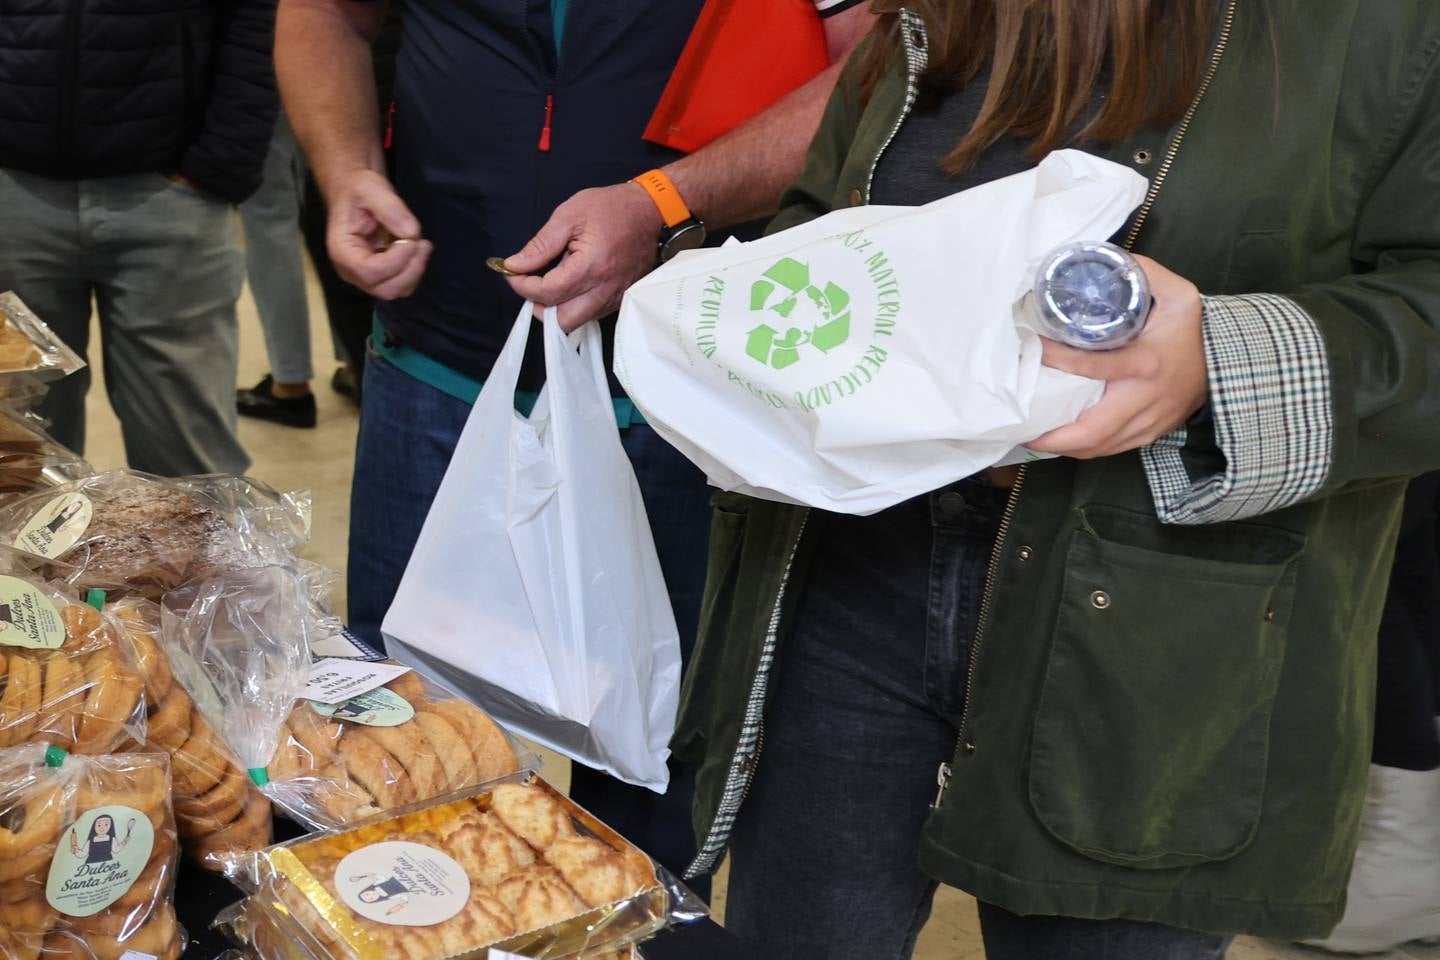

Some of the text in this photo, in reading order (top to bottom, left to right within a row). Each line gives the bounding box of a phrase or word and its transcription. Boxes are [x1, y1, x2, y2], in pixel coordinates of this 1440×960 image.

[863, 250, 901, 338] MATERIAL
[793, 343, 889, 413] RECICLADO
[11, 598, 27, 633] Dulces
[21, 592, 41, 643] Santa Ana
[74, 861, 121, 878] Dulces
[395, 856, 418, 873] Ana
[60, 869, 128, 892] Santa Ana
[392, 866, 427, 895] Dulces
[415, 871, 445, 897] Santa
